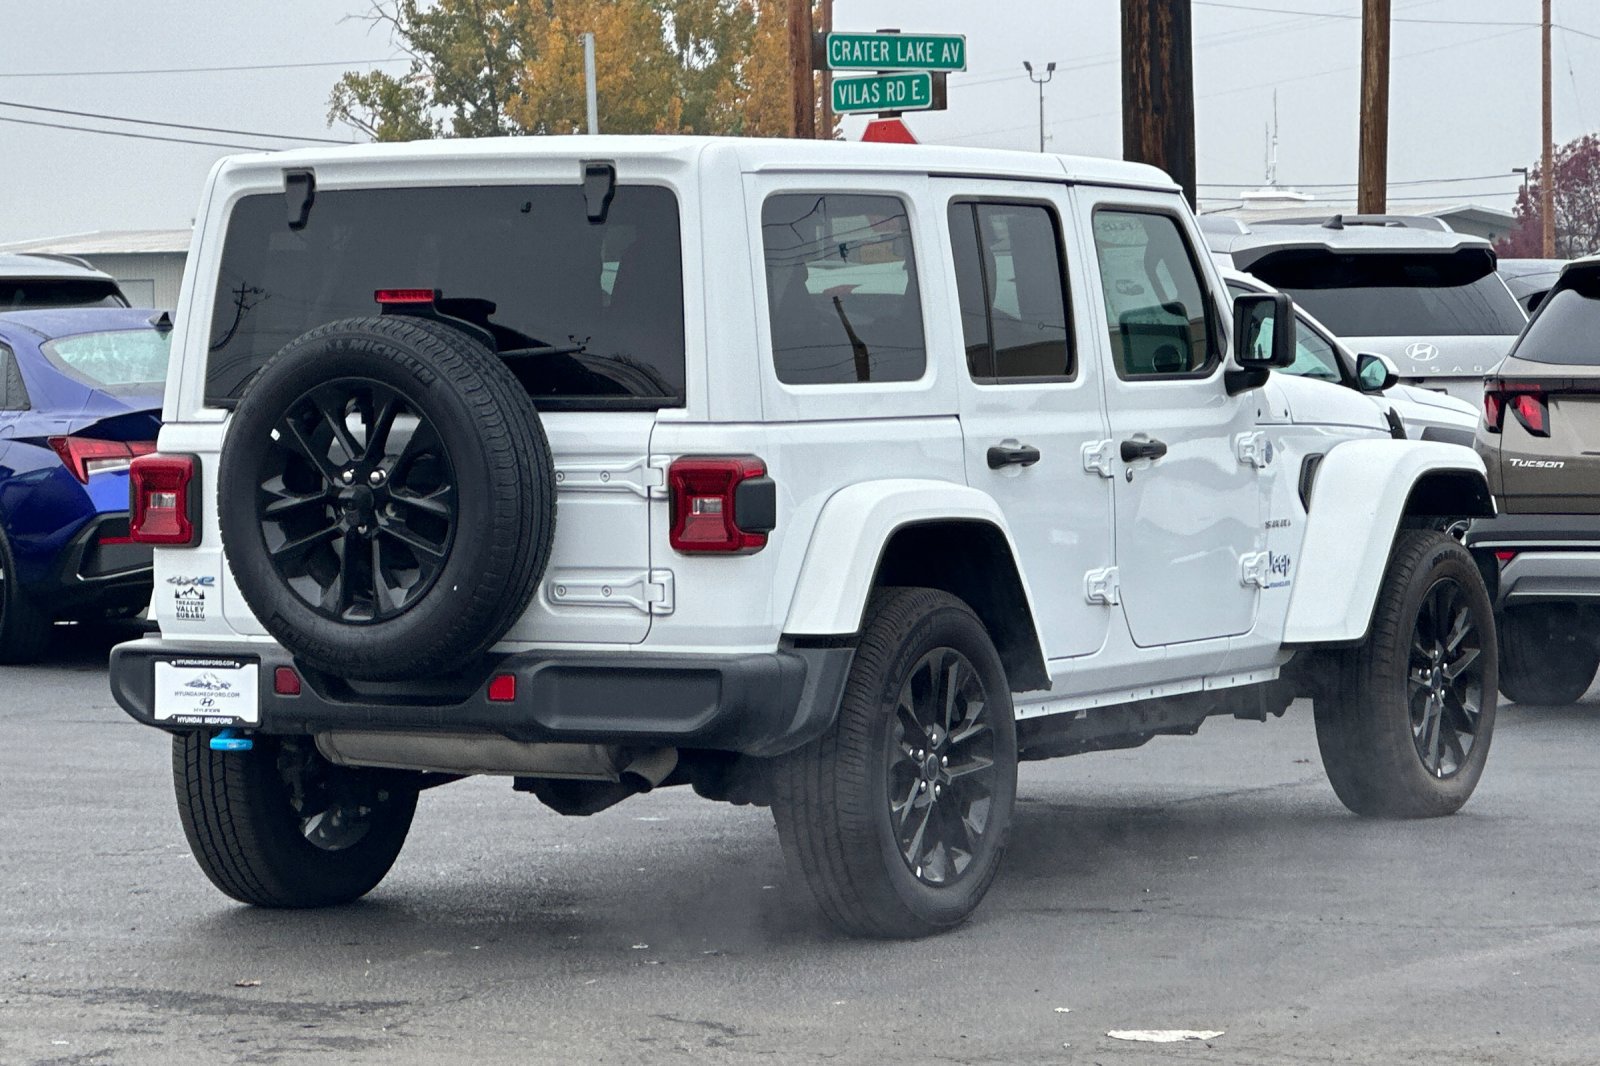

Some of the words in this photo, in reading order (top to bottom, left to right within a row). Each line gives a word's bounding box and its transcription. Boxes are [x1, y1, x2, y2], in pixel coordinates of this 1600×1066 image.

[832, 41, 889, 61] CRATER
[897, 42, 934, 62] LAKE
[941, 43, 960, 63] AV
[838, 82, 880, 104] VILAS
[886, 81, 906, 101] RD
[912, 79, 925, 100] E.
[177, 716, 203, 724] HYUNDAI
